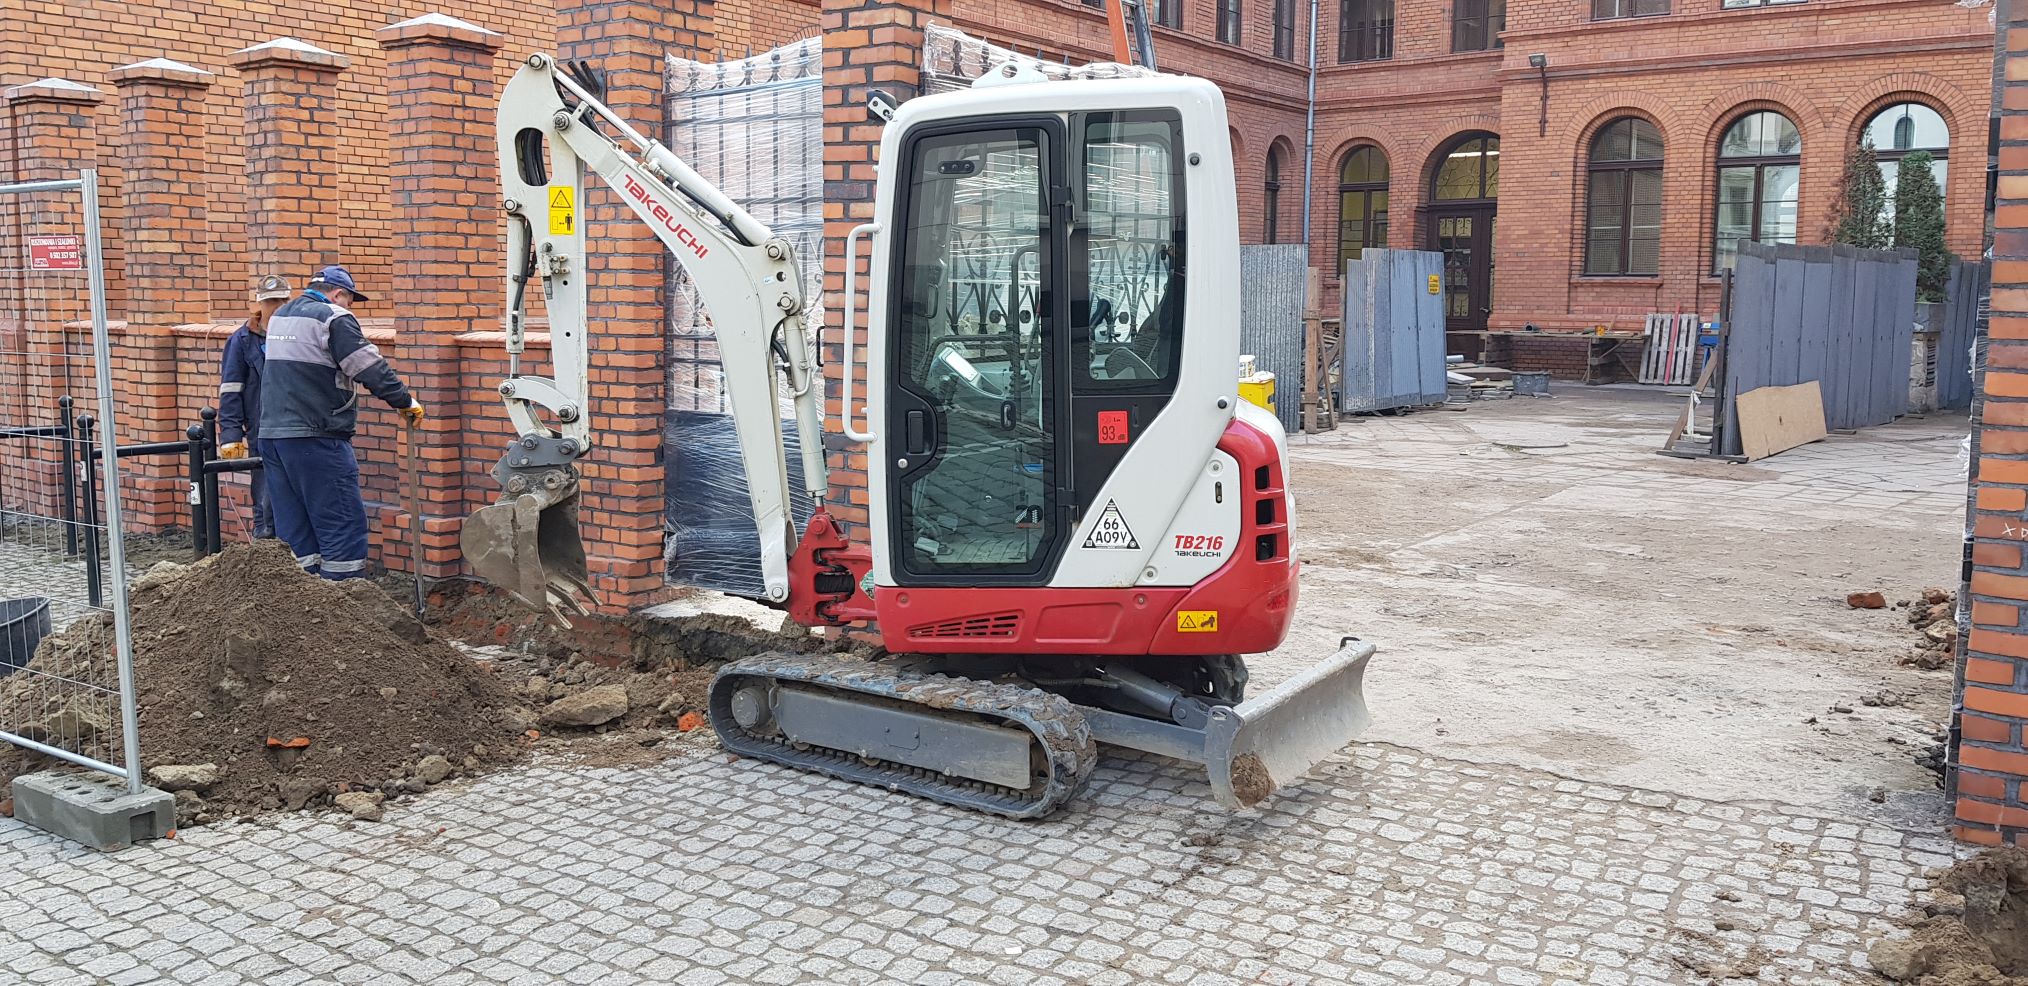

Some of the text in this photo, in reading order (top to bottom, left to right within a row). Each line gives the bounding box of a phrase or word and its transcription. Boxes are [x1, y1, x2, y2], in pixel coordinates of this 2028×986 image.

[1102, 425, 1115, 440] 93
[1103, 518, 1119, 530] 66
[1095, 531, 1127, 543] A09Y
[1175, 535, 1224, 550] TB216
